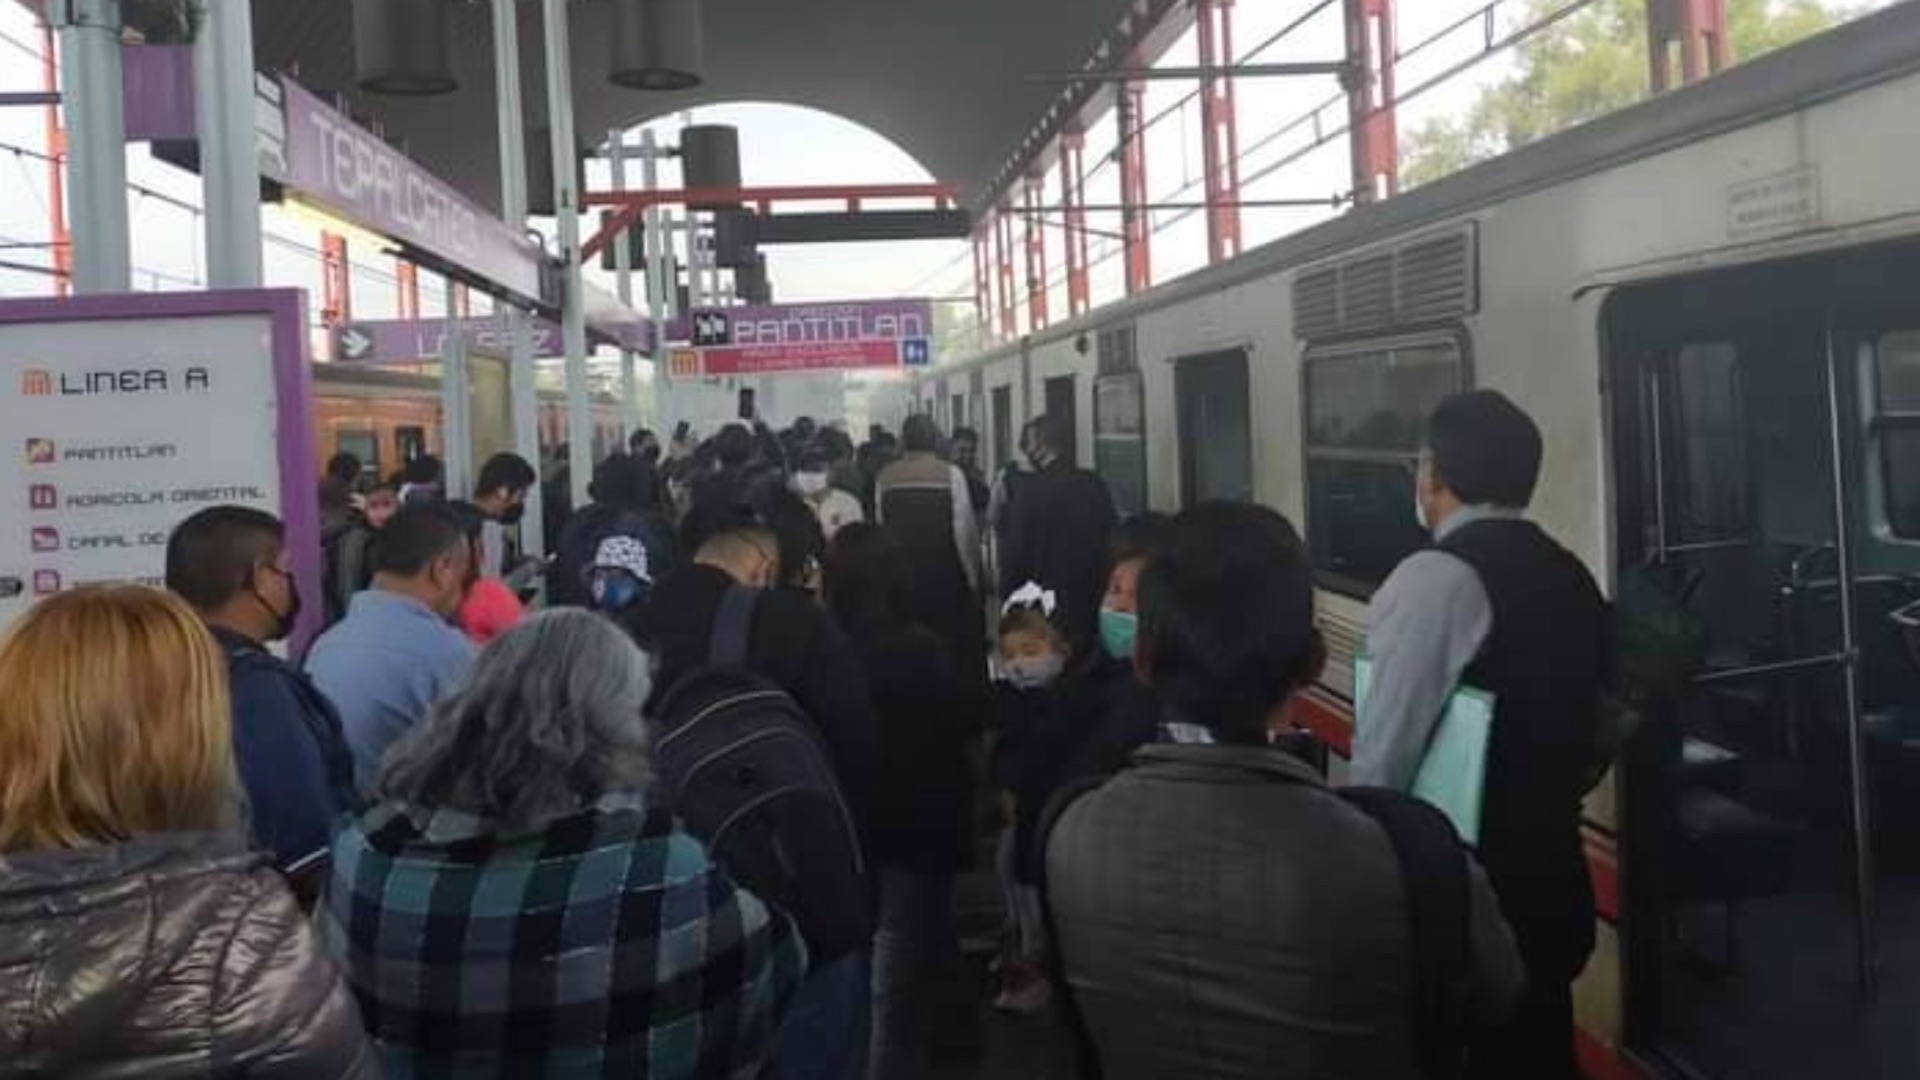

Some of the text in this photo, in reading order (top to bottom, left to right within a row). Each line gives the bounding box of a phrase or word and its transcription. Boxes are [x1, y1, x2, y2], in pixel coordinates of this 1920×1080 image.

[309, 111, 476, 258] TEPALCATES
[734, 313, 922, 346] PANTITLAN
[61, 369, 168, 394] LINEA
[185, 367, 209, 391] A
